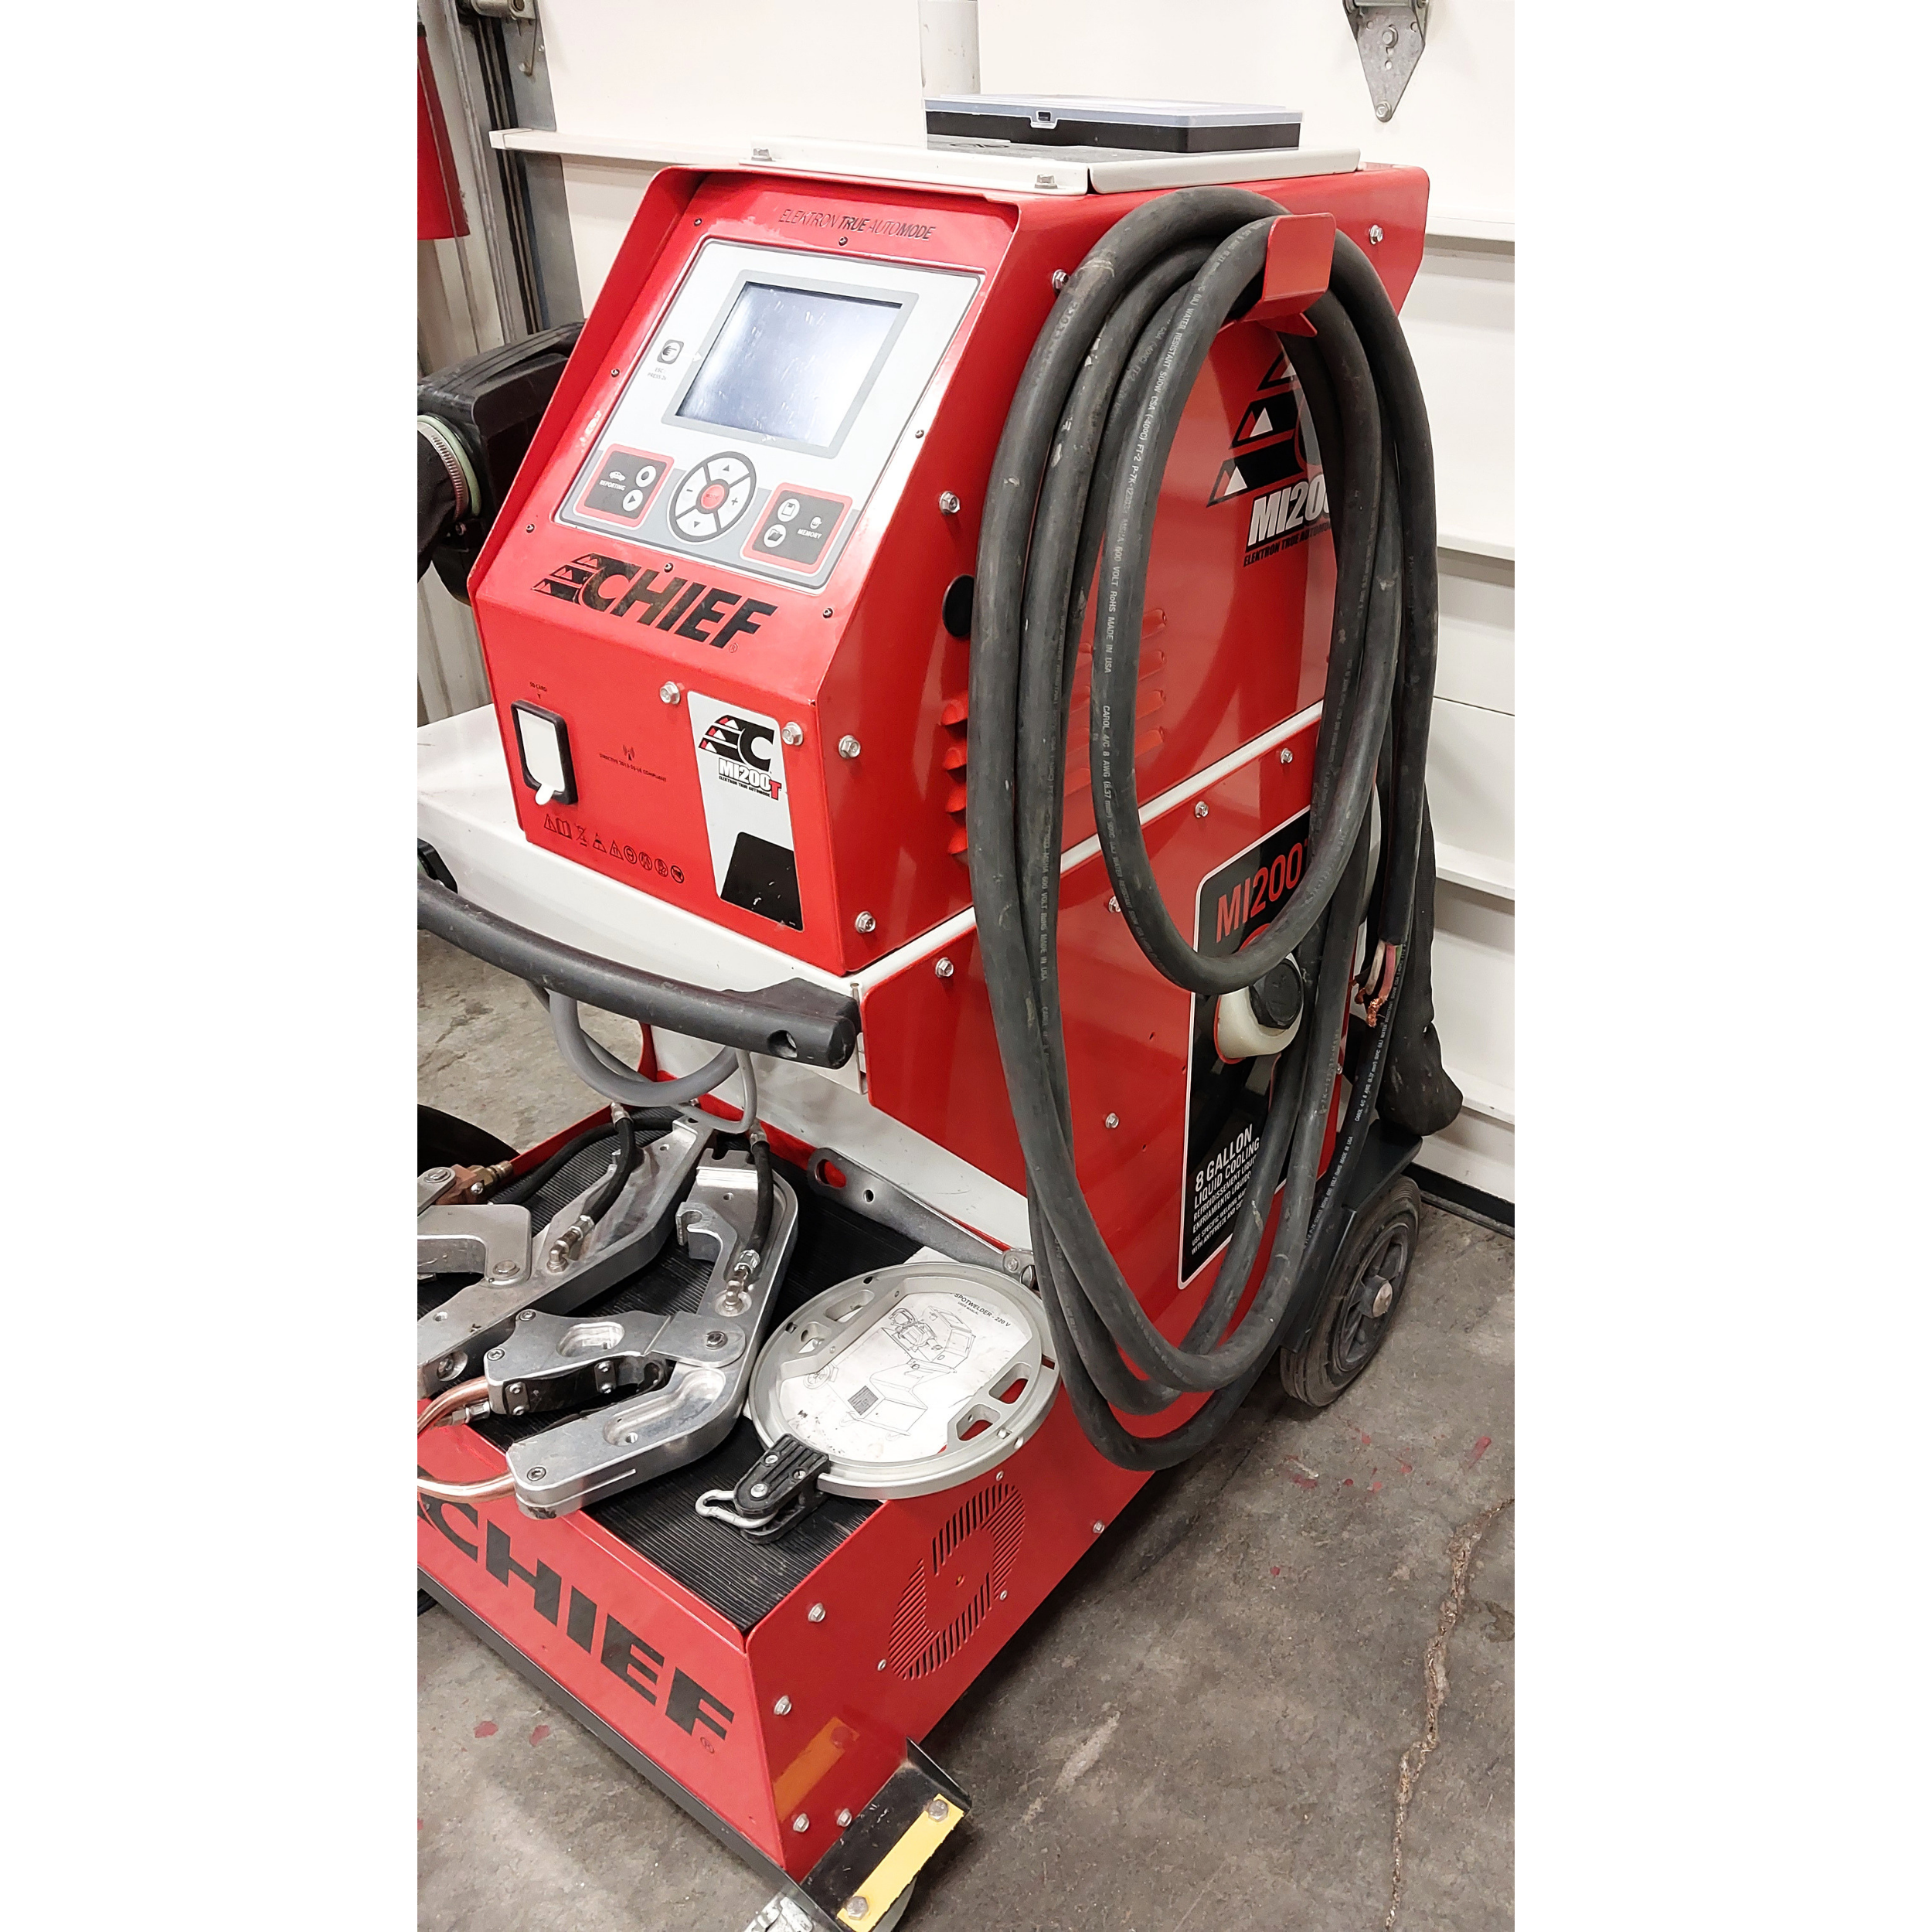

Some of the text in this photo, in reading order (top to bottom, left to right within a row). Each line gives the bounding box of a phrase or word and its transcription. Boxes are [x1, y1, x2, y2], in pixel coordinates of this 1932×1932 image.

[779, 209, 936, 240] ELEKTRON TRUE AUTOMODE
[1177, 308, 1195, 330] WATER
[1162, 332, 1183, 369] RESISTANT
[1148, 395, 1158, 411] CSA
[1134, 444, 1145, 462] FT-2
[599, 479, 627, 492] REPORTING
[1247, 473, 1329, 549] MI20
[797, 528, 822, 539] MEMORY
[1114, 546, 1123, 563] 600
[1243, 542, 1280, 568] ELEKTRON
[1281, 533, 1300, 551] TRUE
[1111, 566, 1121, 587] VOLT
[578, 553, 778, 649] CHIEF
[1108, 590, 1117, 613] RoHS
[1106, 617, 1115, 641] MADE
[1106, 644, 1113, 653] IN
[1102, 705, 1111, 730] CAROL
[643, 769, 667, 782] COMPLIANT
[719, 775, 738, 786] ELEKTRON
[748, 786, 770, 798] AUTOMODE
[1216, 838, 1308, 944] MI200
[1195, 1123, 1253, 1192] 8 GALLON
[1339, 1151, 1348, 1165] MADE
[1194, 1137, 1260, 1210] LIQUID COOLING
[1193, 1172, 1240, 1223] REFROIDISSEMENT
[1192, 1190, 1231, 1234] ENFRIAMIENTO
[1192, 1235, 1201, 1247] USE
[1201, 1215, 1219, 1237] SPECIFIC
[1219, 1196, 1237, 1218] WELDING
[1191, 1240, 1203, 1256] WITH
[1203, 1216, 1227, 1244] ANTIFREEZE
[1226, 1207, 1236, 1219] AND
[954, 1293, 992, 1317] SPOTWELDER
[966, 1306, 979, 1315] MANUAL
